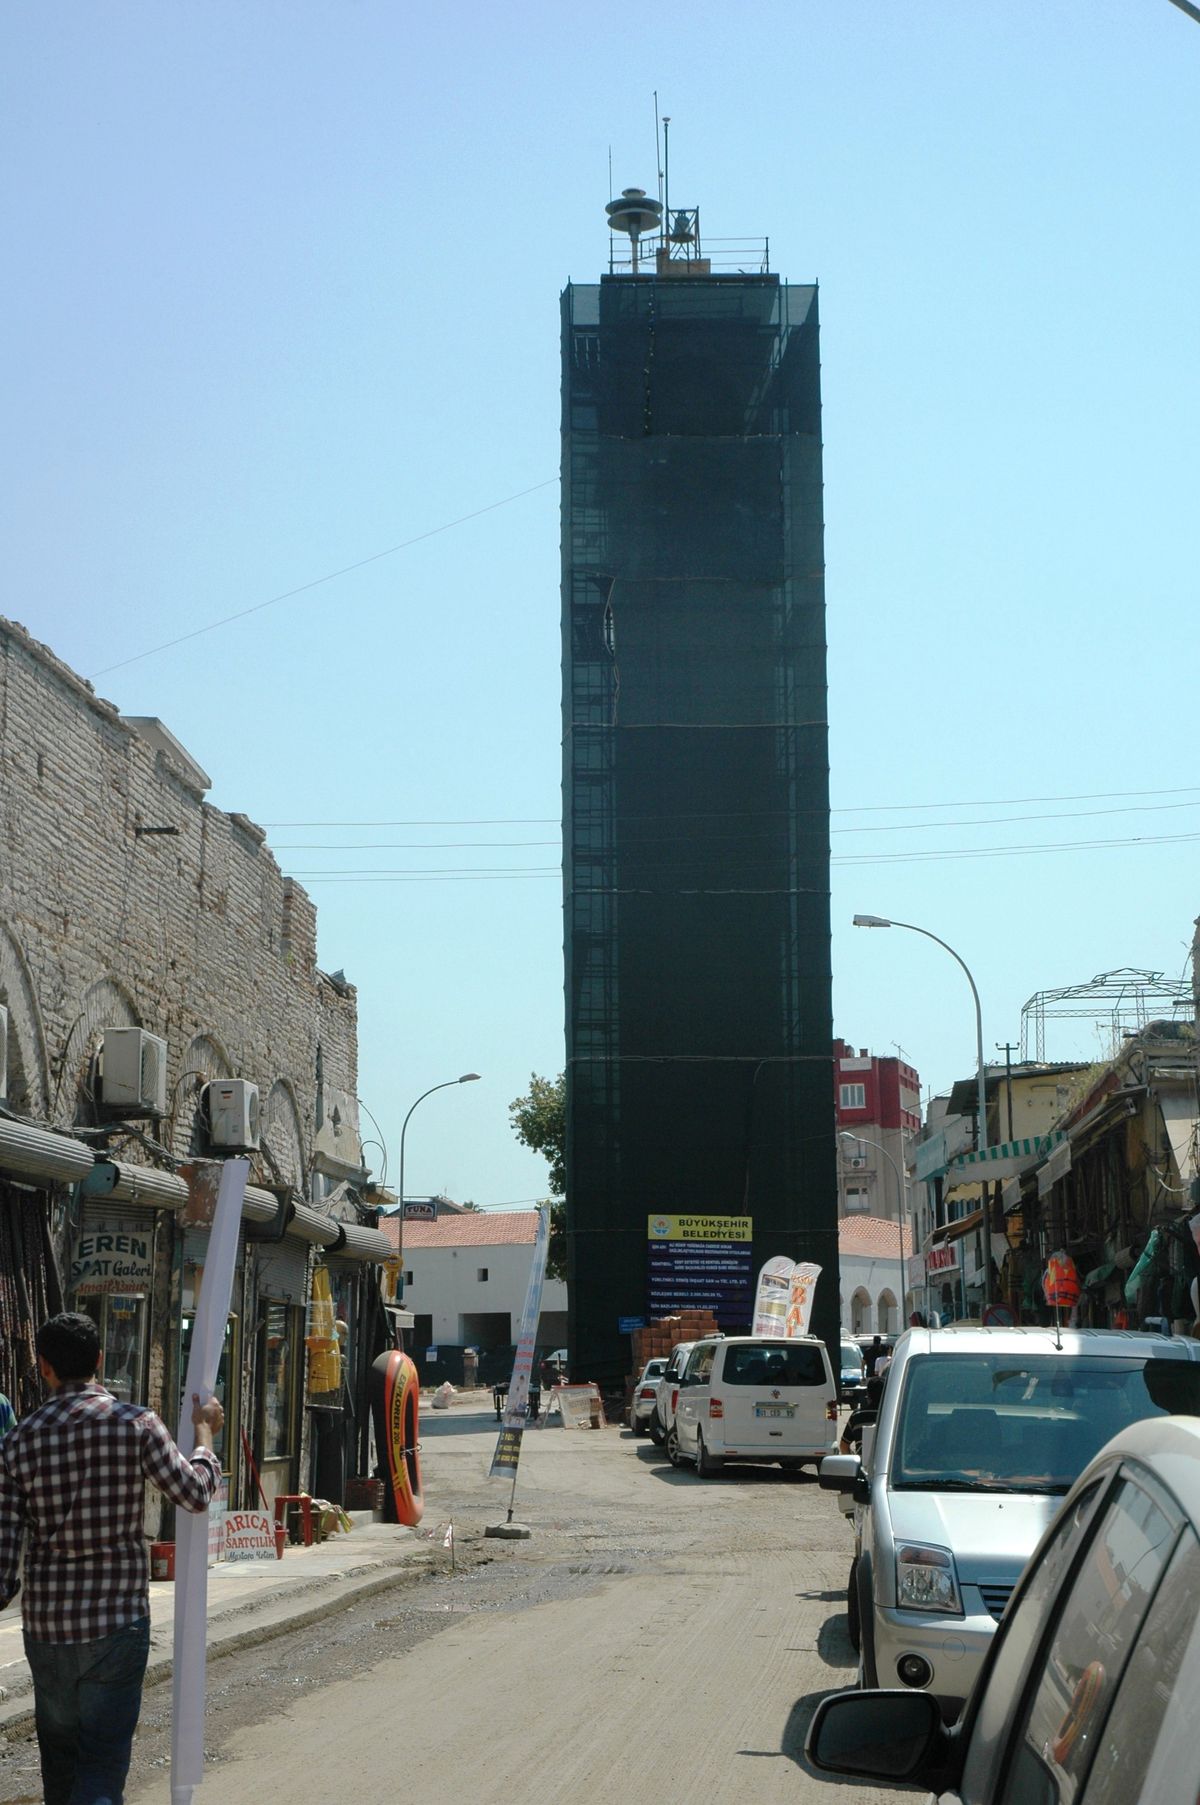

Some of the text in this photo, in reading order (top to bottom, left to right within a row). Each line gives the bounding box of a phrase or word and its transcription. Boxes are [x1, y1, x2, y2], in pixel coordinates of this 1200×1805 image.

[407, 1205, 432, 1213] TUNA
[678, 1217, 749, 1229] BÜYÜKŞEHİR
[682, 1229, 745, 1239] BELEDİYESİ
[79, 1235, 147, 1260] EREN
[72, 1260, 112, 1276] SAAT
[393, 1374, 407, 1429] EXPLORER
[225, 1514, 271, 1537] ARICA
